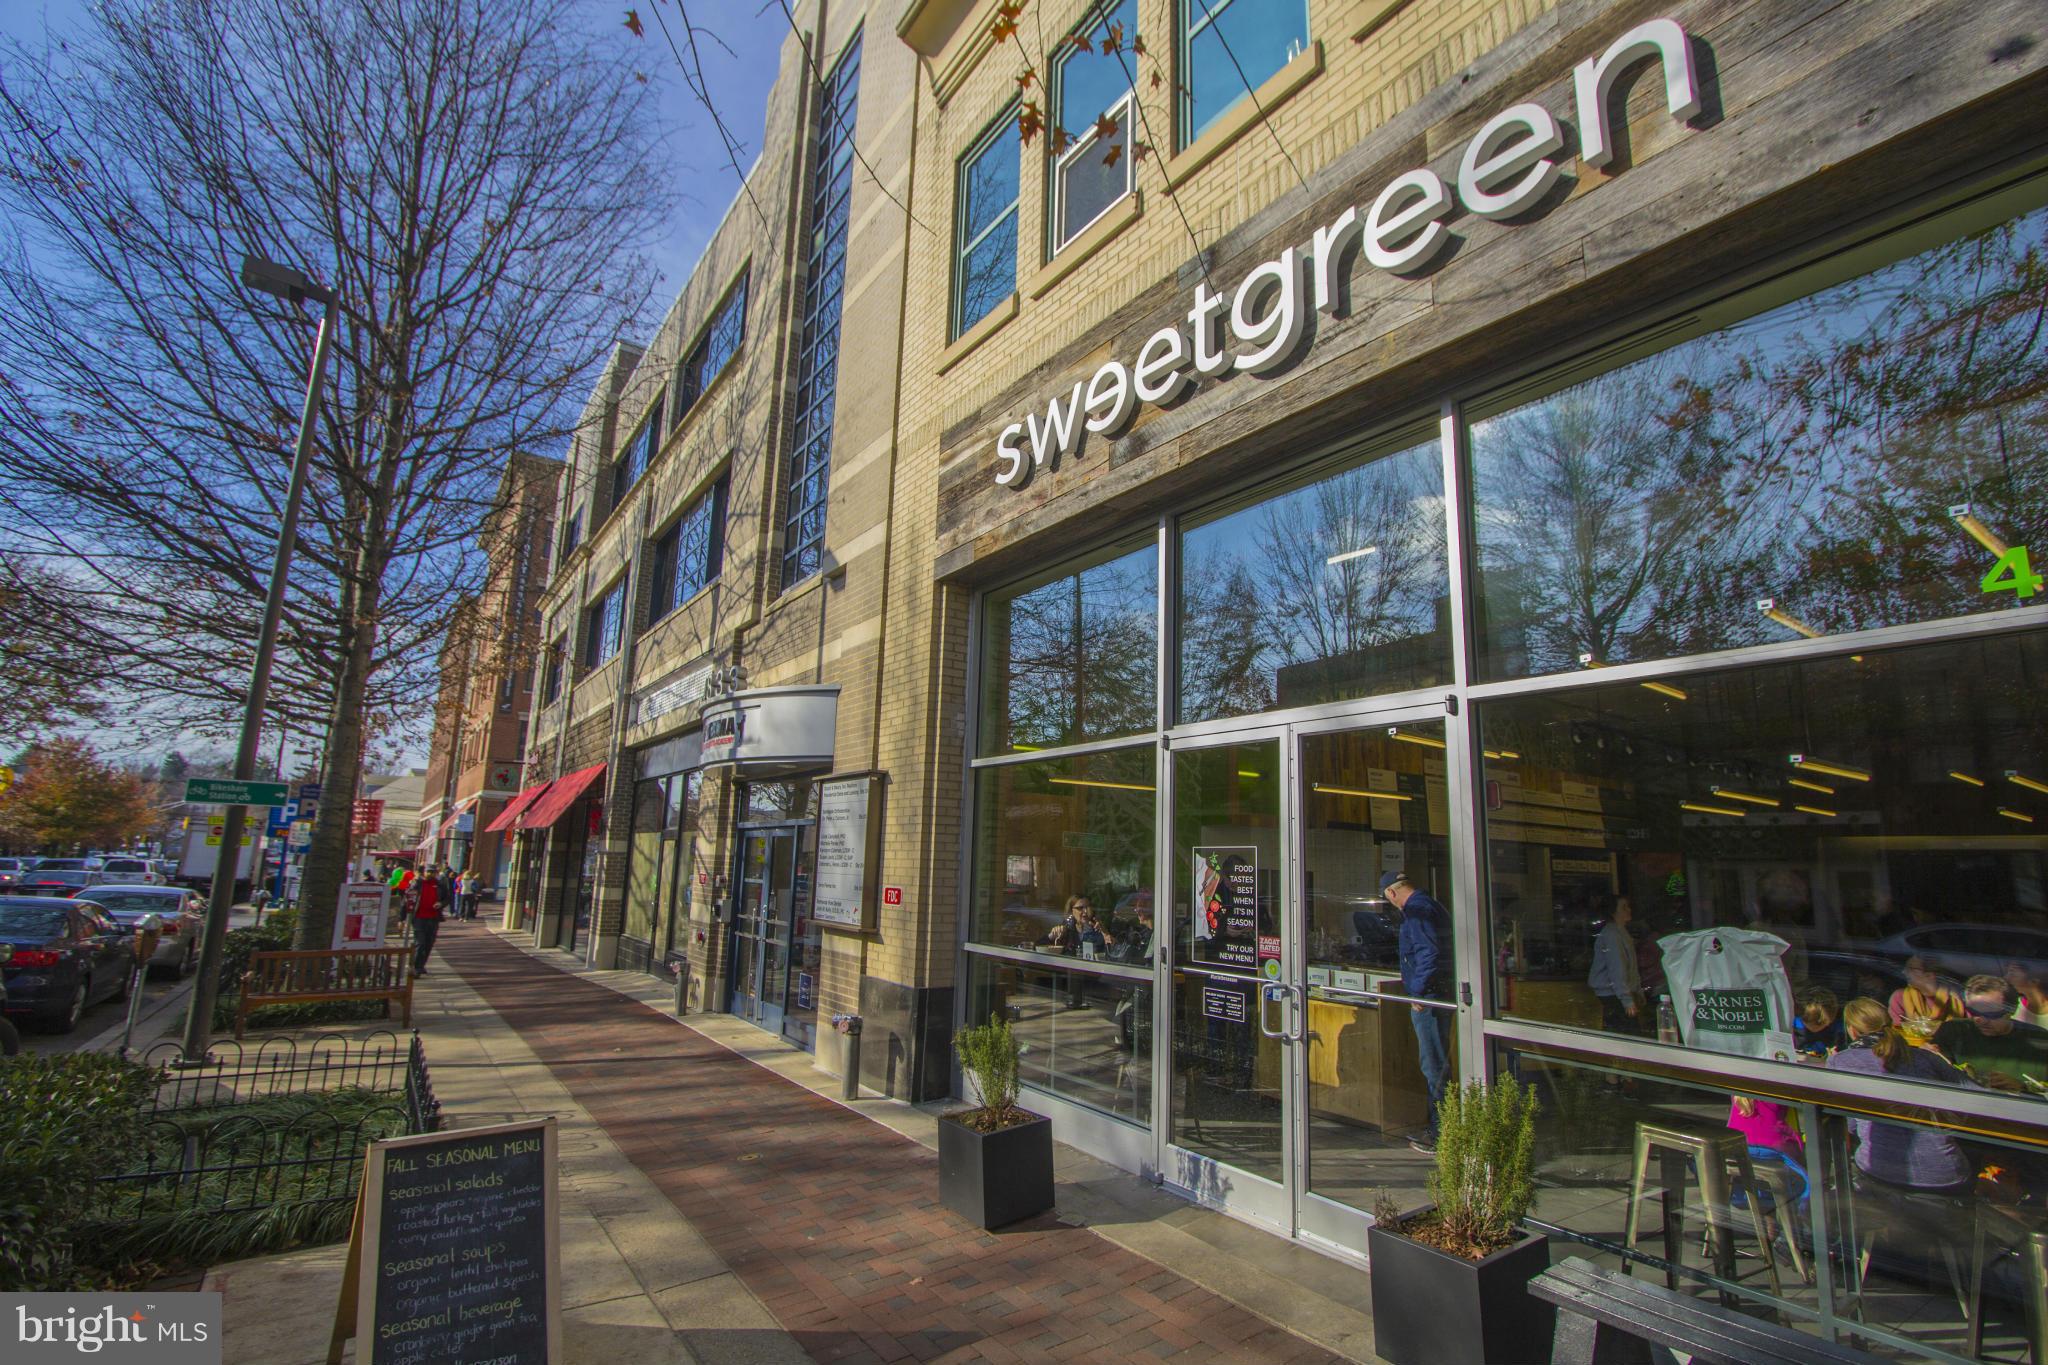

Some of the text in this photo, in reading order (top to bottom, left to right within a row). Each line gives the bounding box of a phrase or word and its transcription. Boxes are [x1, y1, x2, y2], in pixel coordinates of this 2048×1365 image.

[995, 18, 1696, 486] sweetgreen
[1982, 545, 2043, 598] 4
[208, 791, 237, 800] Station
[209, 783, 248, 792] Bikeshare
[281, 803, 298, 822] P
[1234, 865, 1254, 873] FOOD
[1230, 875, 1254, 883] TASTES
[1233, 897, 1254, 905] WHEN
[1227, 918, 1254, 927] SEASON
[1219, 952, 1254, 963] NEW MENU
[1240, 946, 1254, 954] OUR
[1696, 1007, 1765, 1022] & NOBLE
[387, 1138, 542, 1175] FALL SEASONAL MENU
[388, 1171, 504, 1200] seasonal salads
[397, 1216, 440, 1231] roasted
[443, 1211, 474, 1225] turkey
[398, 1232, 429, 1247] curry
[384, 1242, 506, 1277] seasonal soups
[397, 1274, 443, 1294] organic
[395, 1295, 441, 1317] organic
[447, 1280, 499, 1298] butternut
[380, 1297, 523, 1339] seasonal beverage
[489, 1315, 515, 1339] green
